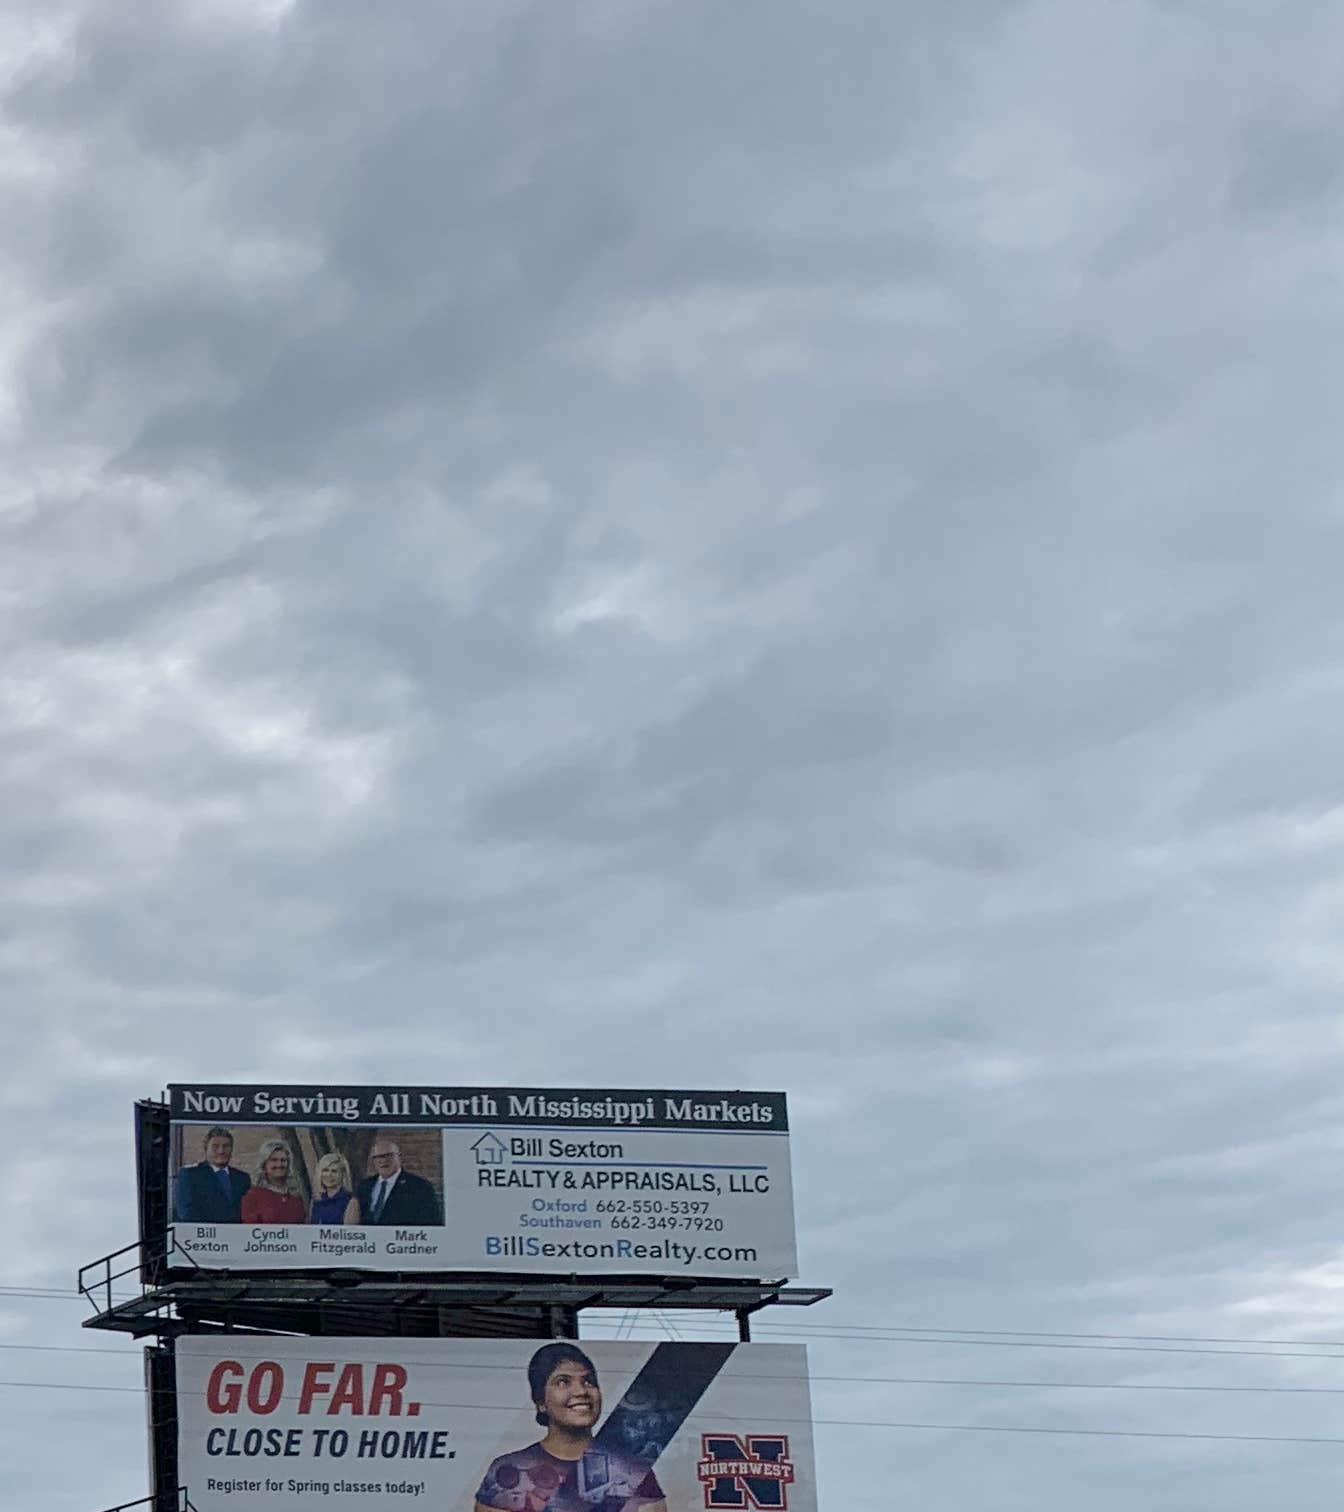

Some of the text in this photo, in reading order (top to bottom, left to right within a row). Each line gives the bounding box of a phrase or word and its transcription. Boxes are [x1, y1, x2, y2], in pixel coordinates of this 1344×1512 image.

[183, 1091, 773, 1125] Now Serving All North Mississippi Markets
[510, 1137, 624, 1159] Bill Sexton
[478, 1169, 771, 1196] REALTY & APPRAISALS, LLC
[531, 1198, 710, 1215] Oxford 662-550-5397
[519, 1214, 724, 1232] Southaven 662-349-7920
[196, 1227, 217, 1239] Bill
[251, 1228, 290, 1243] Cyndi
[319, 1228, 367, 1242] Melissa
[394, 1229, 428, 1243] Mark
[184, 1239, 230, 1253] Sexton
[243, 1240, 298, 1254] Johnson
[311, 1241, 377, 1257] Fitzgerald
[385, 1242, 439, 1256] Gardner
[485, 1236, 758, 1266] BillSextonRealty.com
[206, 1359, 423, 1417] GO FAR.
[206, 1427, 457, 1460] CLOSE TO HOME.
[699, 1462, 791, 1477] NORTHWEST
[207, 1478, 426, 1497] Register for Spring classes today!
